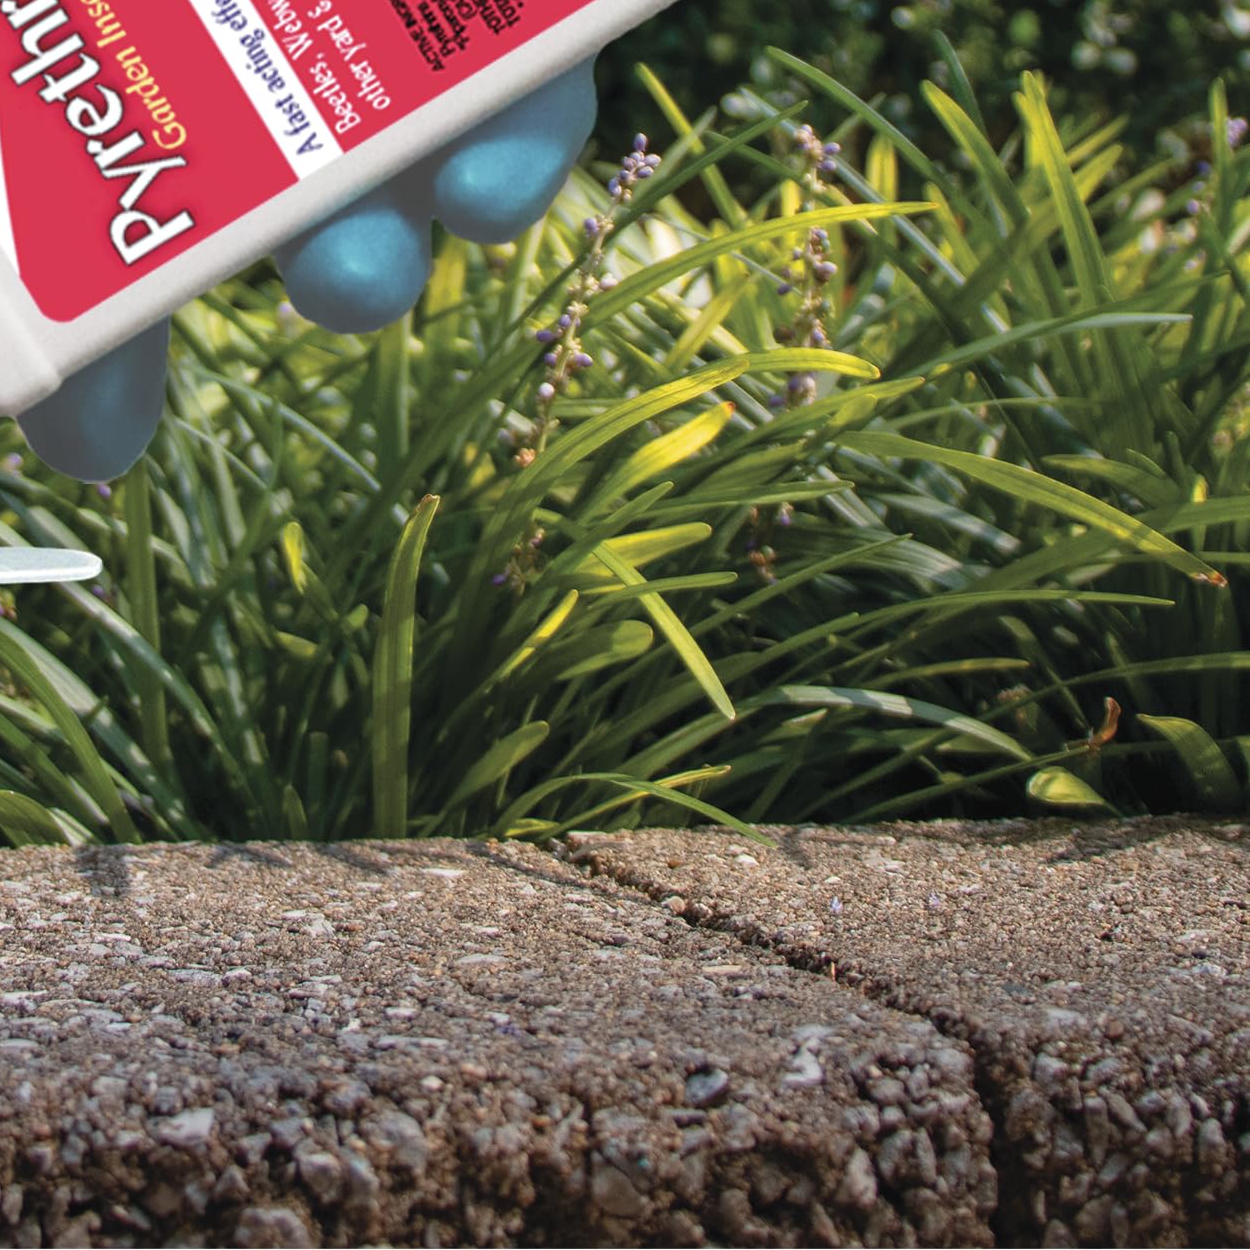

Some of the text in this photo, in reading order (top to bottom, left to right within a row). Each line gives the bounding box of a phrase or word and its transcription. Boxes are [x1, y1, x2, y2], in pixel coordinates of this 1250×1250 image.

[306, 0, 332, 18] &
[239, 28, 286, 92] acting
[316, 14, 366, 61] yard
[115, 45, 187, 149] Garden
[309, 52, 361, 134] Beetles,
[349, 60, 391, 109] other
[274, 93, 310, 136] fast
[296, 131, 323, 155] A
